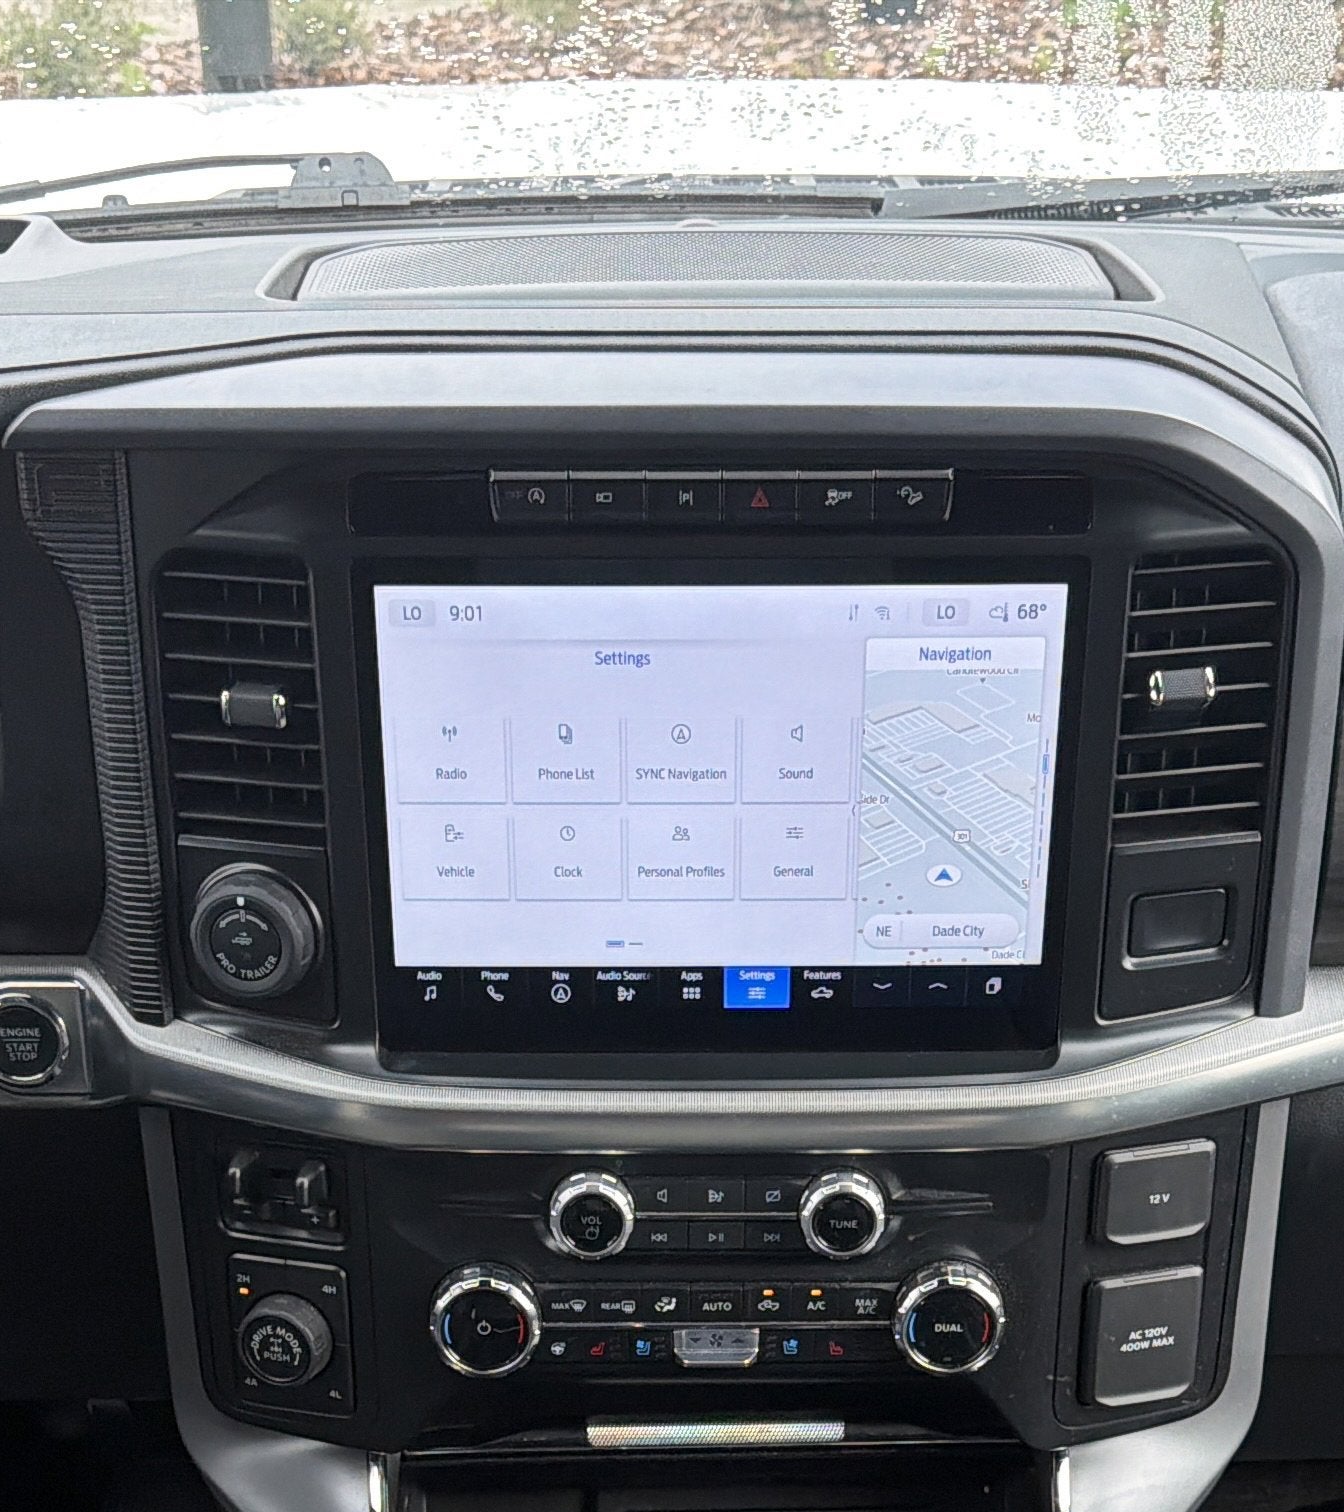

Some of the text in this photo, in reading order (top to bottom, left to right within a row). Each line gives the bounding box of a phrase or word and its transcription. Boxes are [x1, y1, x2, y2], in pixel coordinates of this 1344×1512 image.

[838, 491, 852, 499] OFF
[402, 605, 422, 620] LO
[449, 605, 482, 622] 9:01
[937, 605, 956, 620] LO
[1017, 603, 1047, 619] 68°
[594, 651, 651, 668] Settings
[919, 646, 992, 663] Navigation
[436, 767, 467, 780] Radio
[538, 767, 595, 780] Phone List
[635, 768, 727, 782] SYNC Navigation
[778, 767, 814, 780] Sound
[436, 866, 475, 878] Vehicle
[554, 866, 583, 878] Clock
[637, 866, 725, 878] Personal Profiles
[773, 866, 814, 877] General
[875, 925, 892, 937] NE
[932, 925, 985, 938] Dade City
[991, 950, 1015, 959] Dade
[216, 952, 277, 979] PRO TRAILER
[417, 970, 442, 981] Audio
[480, 970, 509, 981] Phone
[552, 971, 570, 981] Nav
[596, 970, 622, 980] Audio
[680, 970, 703, 982] Apps
[739, 970, 775, 982] Settings
[803, 970, 841, 980] Features
[0, 1027, 41, 1037] ENGINE
[5, 1043, 39, 1052] START
[9, 1052, 37, 1061] STOP
[1149, 1193, 1170, 1204] 12 V
[580, 1215, 602, 1226] VOL
[829, 1219, 858, 1230] TUNE
[236, 1273, 251, 1283] 2H
[321, 1284, 337, 1294] 4H
[600, 1302, 621, 1310] REAR
[702, 1302, 732, 1312] AUTO
[806, 1301, 826, 1311] A/C
[855, 1299, 878, 1307] MAX
[856, 1306, 876, 1315] A/C
[934, 1323, 963, 1333] DUAL
[1128, 1326, 1169, 1340] AC 120V
[250, 1324, 303, 1355] DRIVE MODE
[1120, 1335, 1174, 1352] 400W MAX
[263, 1352, 291, 1362] PUSH
[329, 1389, 343, 1400] 4L
